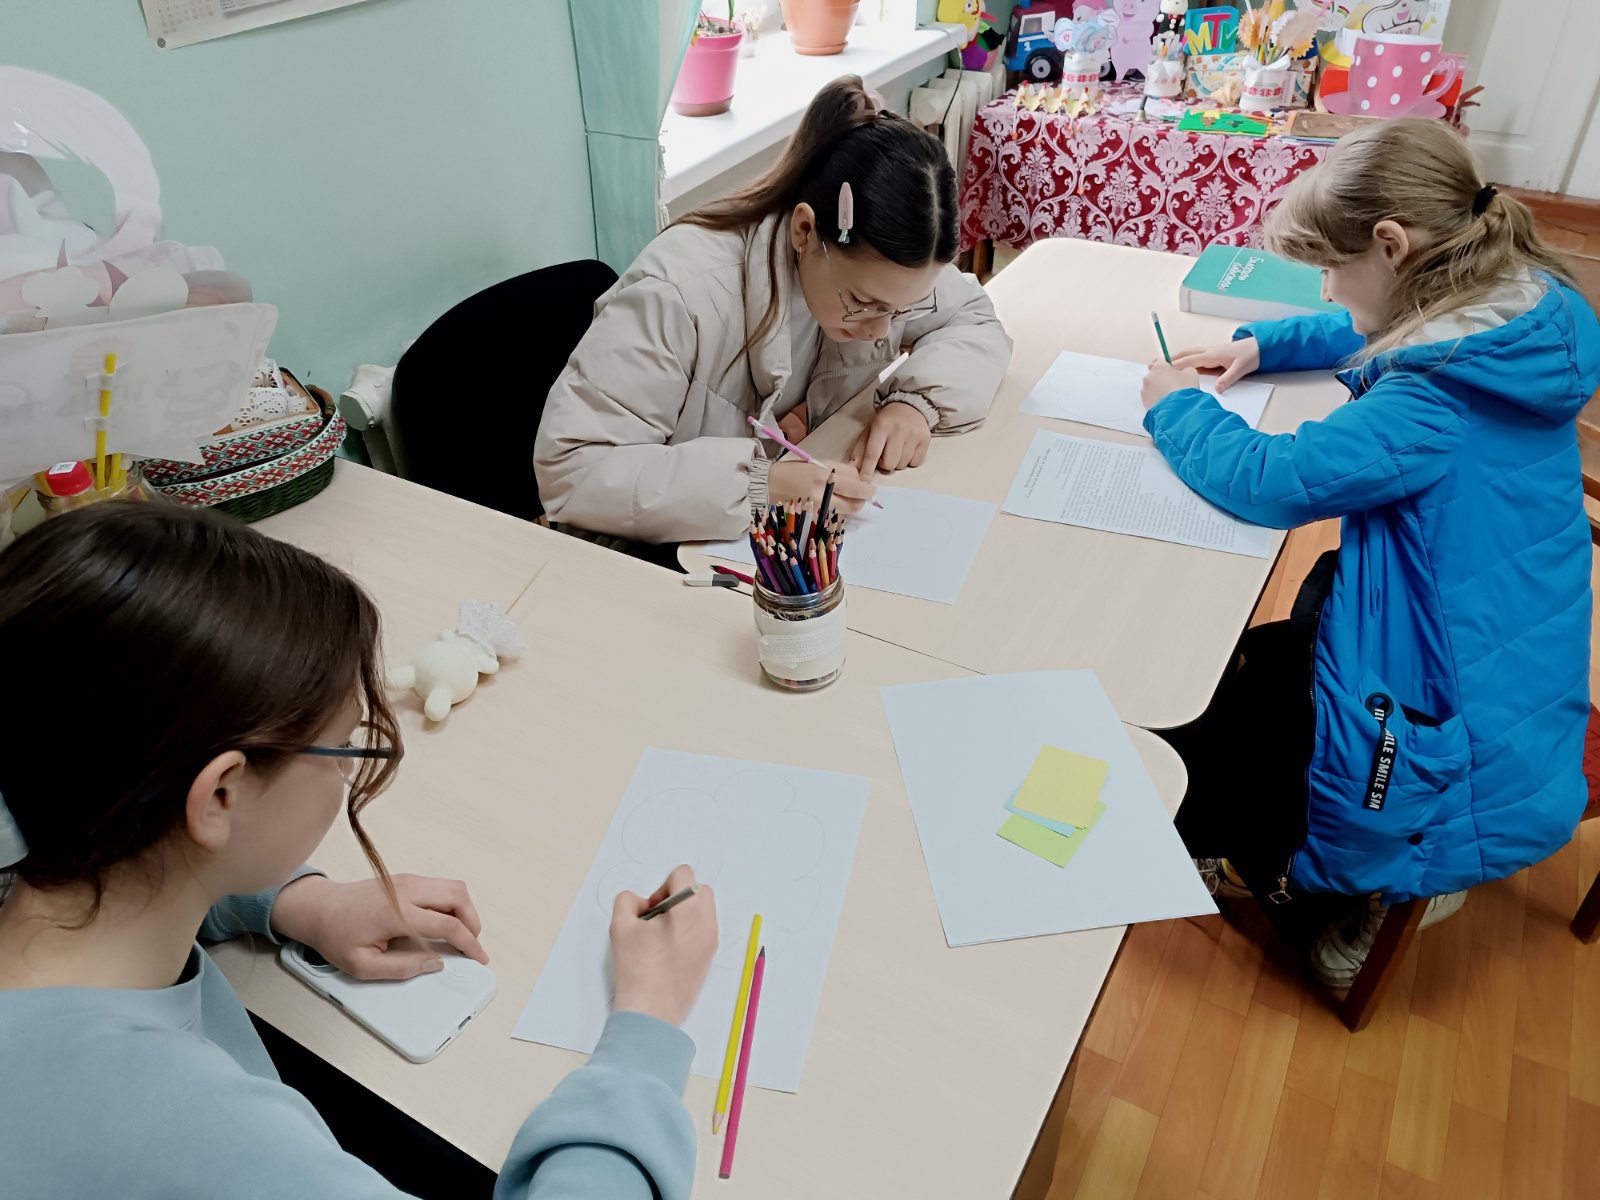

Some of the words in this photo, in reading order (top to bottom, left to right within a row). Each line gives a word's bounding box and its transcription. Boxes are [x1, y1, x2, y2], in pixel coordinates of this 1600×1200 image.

[1024, 41, 1032, 51] 1
[1185, 13, 1238, 56] MTV
[1374, 756, 1391, 790] SMILE
